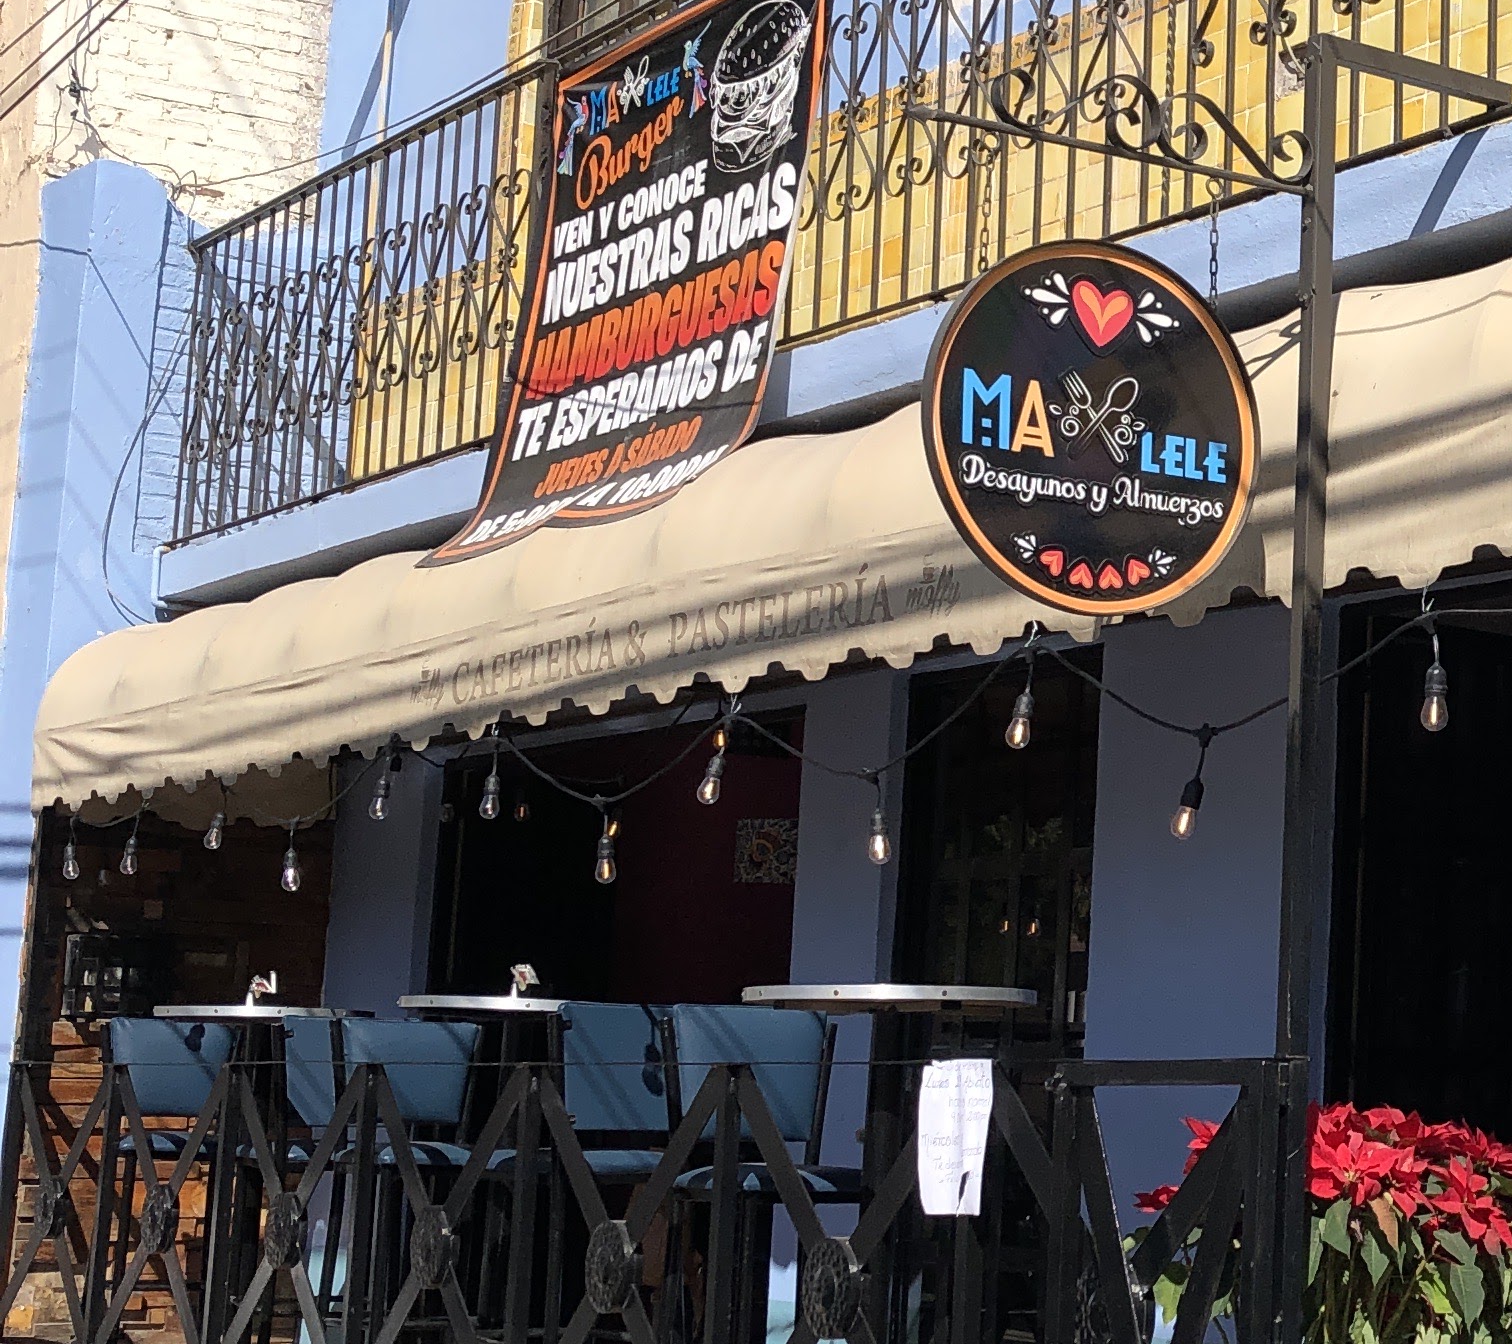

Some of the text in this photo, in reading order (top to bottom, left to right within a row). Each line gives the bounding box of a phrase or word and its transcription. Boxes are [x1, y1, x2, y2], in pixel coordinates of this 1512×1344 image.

[554, 159, 708, 259] VEN Y CONOCE
[575, 96, 685, 210] Burger
[541, 162, 796, 326] NUESTRAS RICAS
[525, 240, 786, 400] HAMBURGUESAS
[511, 321, 769, 462] TE ESPERAMOS DE
[962, 367, 1228, 484] MA LELE
[534, 416, 703, 499] JUEVES A SÁBADO
[962, 454, 1224, 525] Desayunos y Almuerzos
[459, 514, 507, 546] DE
[452, 616, 616, 705] CAFETERÍA
[624, 619, 648, 666] &
[668, 563, 894, 657] PASTELERÍA
